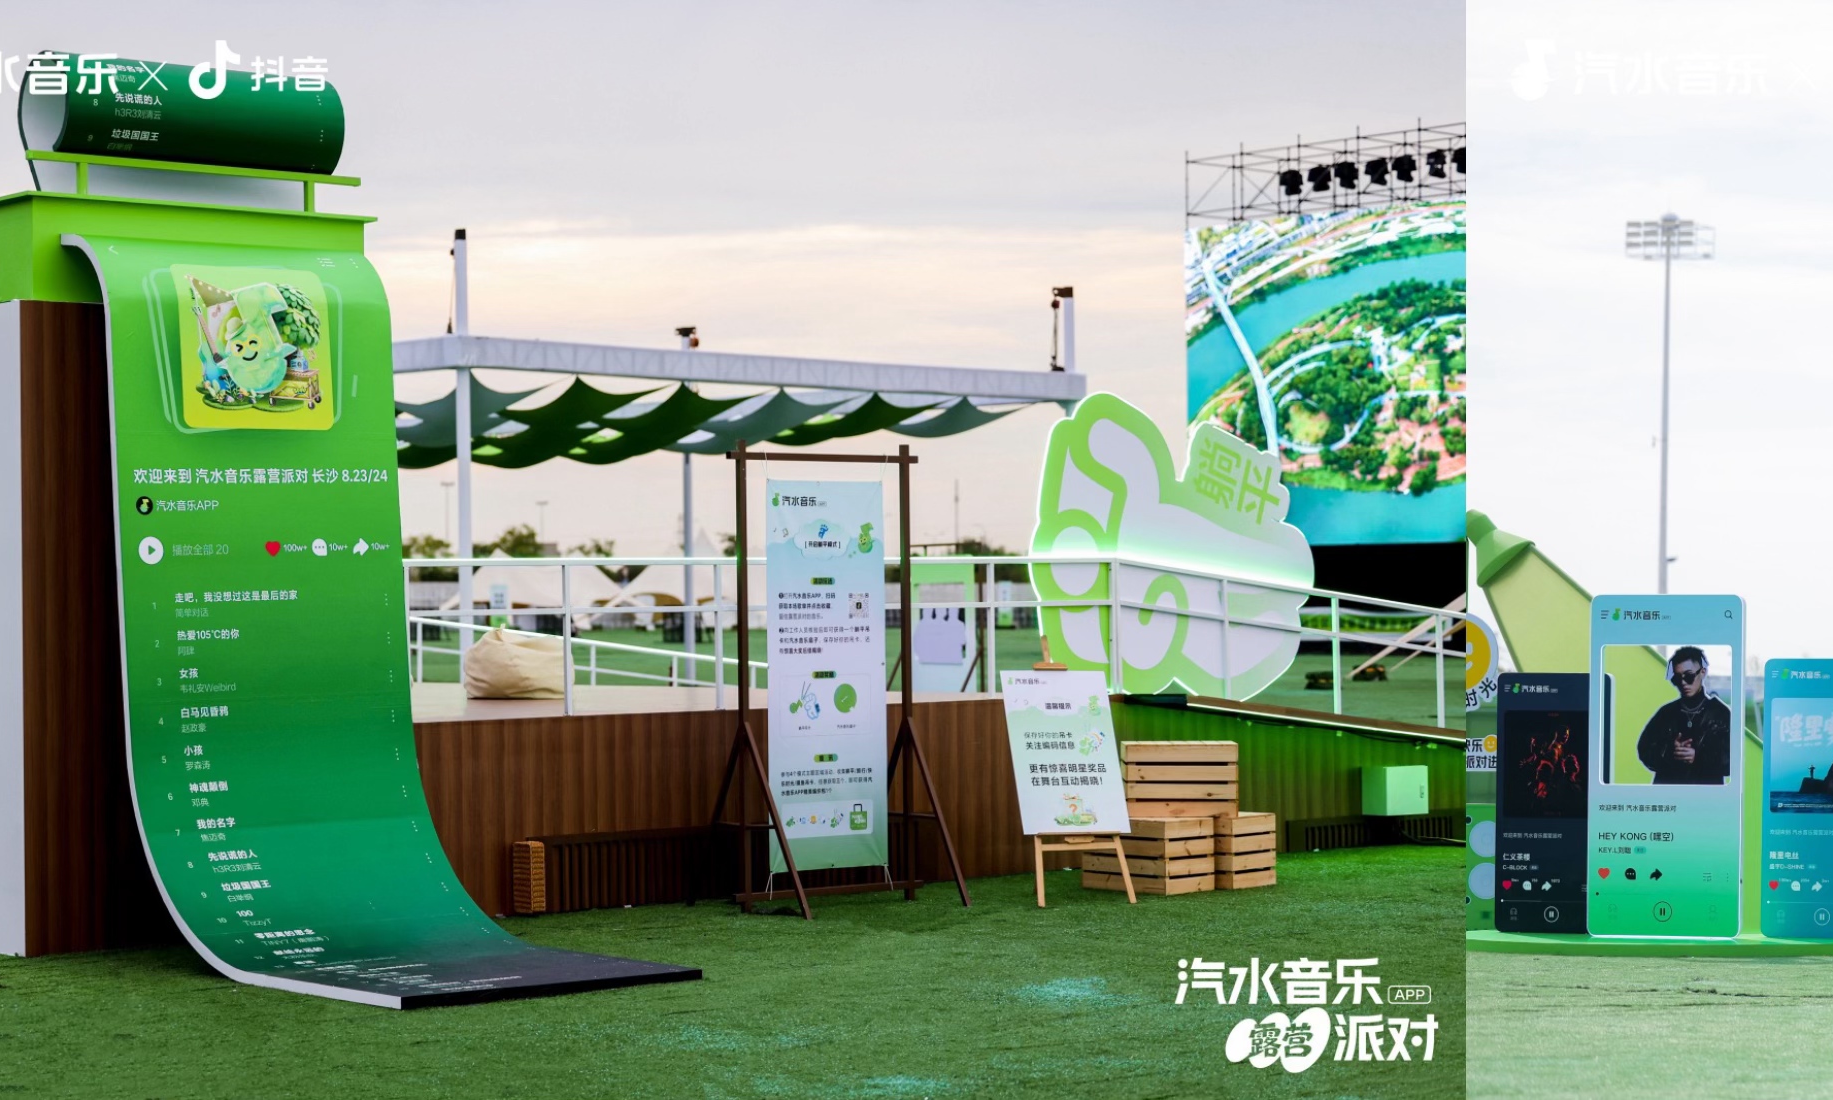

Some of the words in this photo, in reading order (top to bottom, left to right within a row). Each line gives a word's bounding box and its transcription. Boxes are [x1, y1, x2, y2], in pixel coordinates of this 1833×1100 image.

[115, 93, 163, 106] 先说谎的人
[134, 468, 192, 484] 欢迎来到
[195, 468, 308, 484] 汽水音乐露营派对
[312, 468, 339, 484] 长沙
[342, 469, 388, 484] 8.23/24
[156, 500, 219, 512] 汽水音乐APP
[782, 496, 817, 506] 汽水音乐
[172, 544, 213, 556] 播放全部
[216, 544, 229, 555] 20
[284, 543, 307, 552] 100w+
[328, 542, 348, 551] 10w+
[371, 542, 390, 550] 10w+
[1624, 610, 1660, 620] 汽水音乐
[155, 640, 160, 648] 2
[179, 668, 199, 679] 女孩
[157, 678, 162, 686] 3
[158, 717, 164, 725] 4
[183, 745, 203, 756] 小孩
[1026, 742, 1075, 750] 关注编码信息
[1029, 763, 1107, 773] 更有惊喜明星奖品
[168, 793, 173, 801] 6
[196, 817, 236, 830] 我的名字
[1598, 832, 1616, 840] HEY
[1620, 832, 1647, 841] KONG
[187, 861, 194, 869] 8
[201, 891, 207, 899] 9
[236, 909, 254, 917] 100
